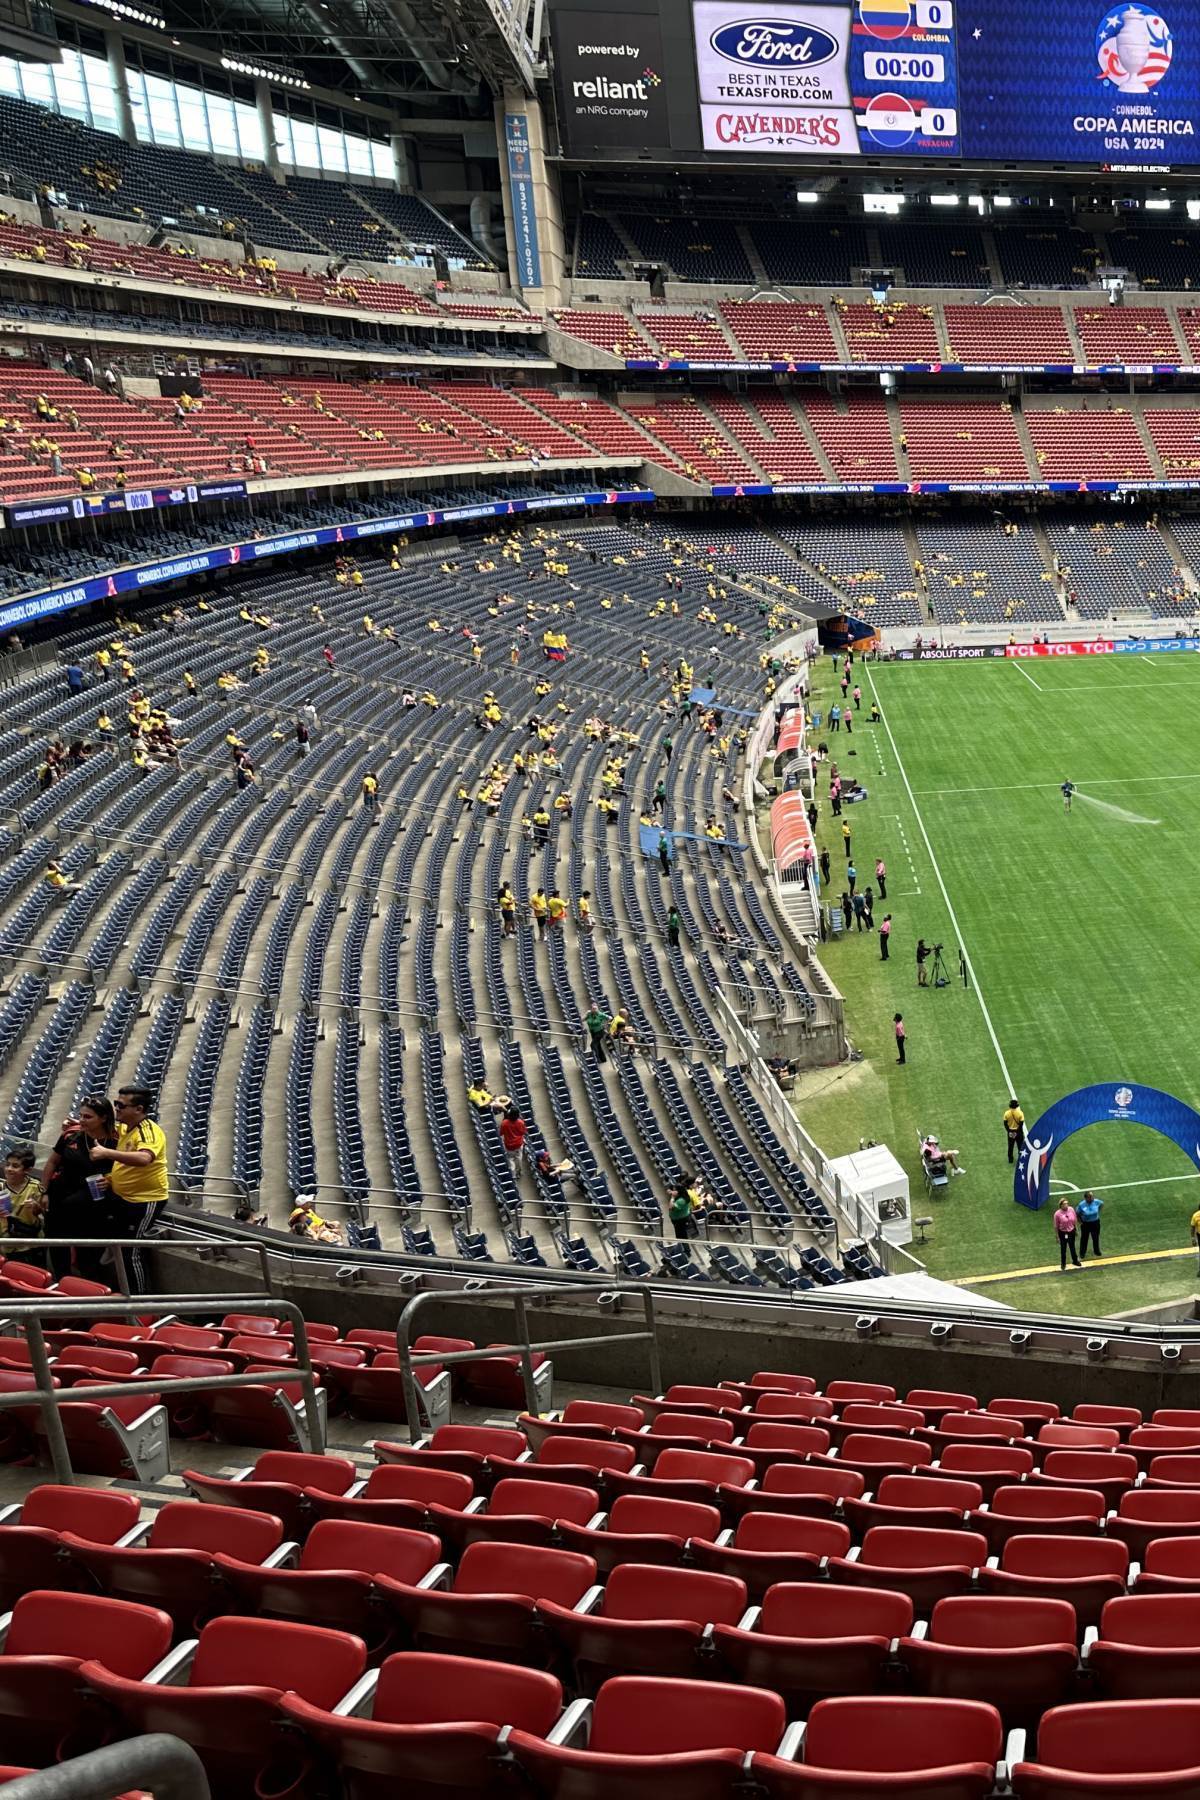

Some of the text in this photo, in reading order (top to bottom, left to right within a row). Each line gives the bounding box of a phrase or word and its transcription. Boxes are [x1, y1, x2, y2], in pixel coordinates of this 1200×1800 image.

[929, 6, 941, 23] 0
[737, 25, 813, 61] Ford
[912, 34, 950, 43] COLOMBIA
[578, 44, 640, 58] powered by
[876, 58, 934, 78] 00:00
[729, 74, 820, 87] BEST IN TEXAS
[573, 76, 648, 100] reliant
[718, 86, 833, 100] TEXASFORD.COM
[588, 106, 608, 114] NRG
[609, 108, 648, 118] company
[716, 113, 840, 146] CAVENDER'S
[933, 114, 945, 131] 0
[1074, 116, 1194, 135] COPA AMERICA
[1104, 137, 1164, 150] USA 2024
[920, 650, 958, 658] ABSOLUT
[958, 649, 986, 658] SPORT
[1007, 646, 1038, 656] TCL
[1045, 644, 1076, 655] TCL
[1083, 642, 1114, 654] TCL
